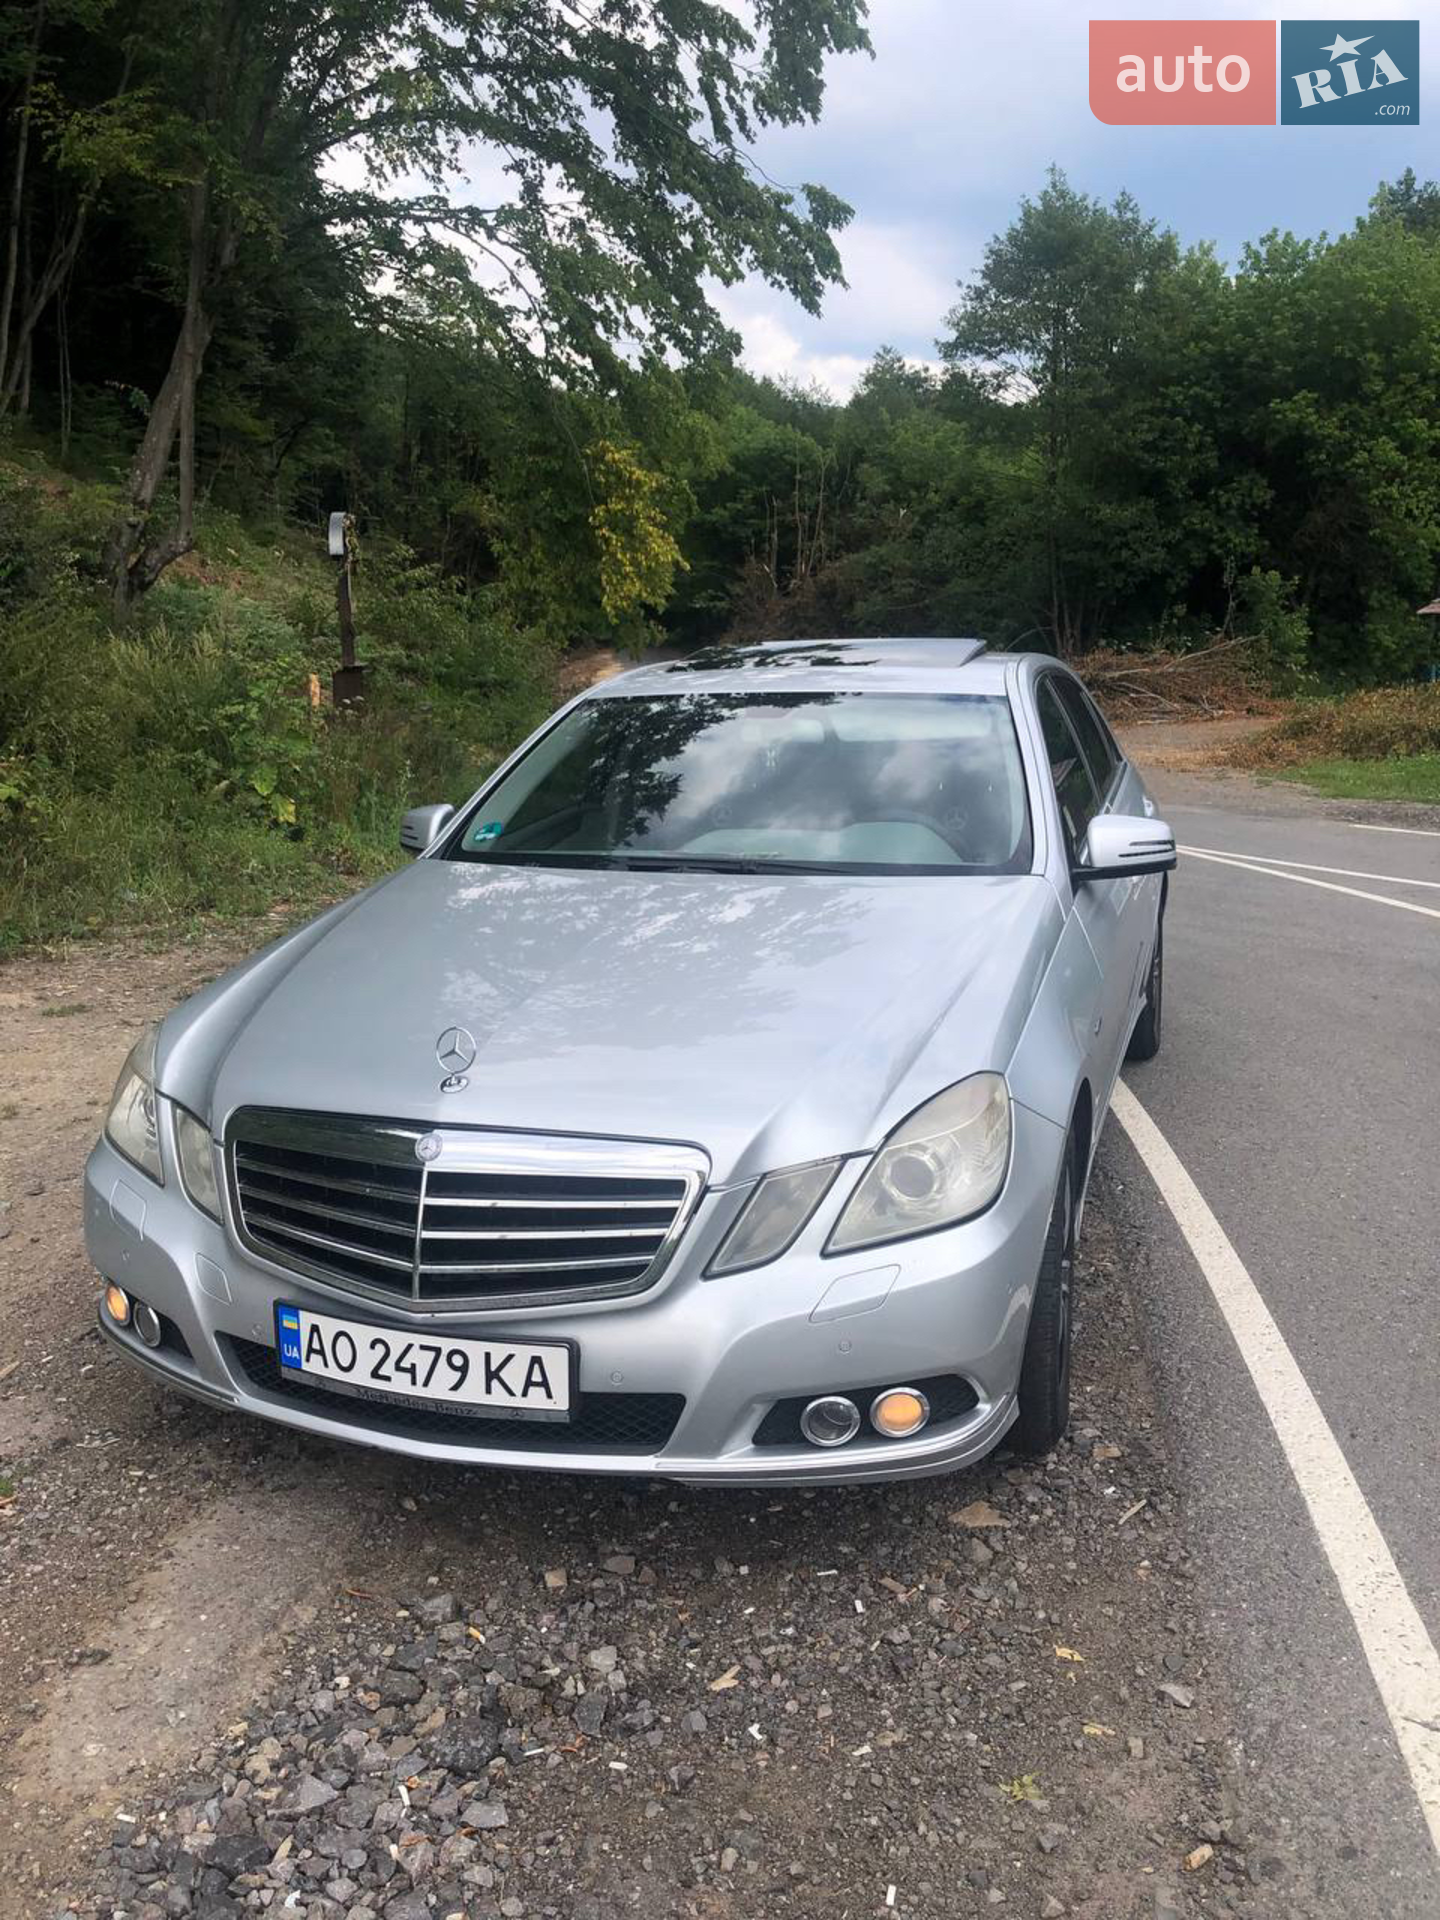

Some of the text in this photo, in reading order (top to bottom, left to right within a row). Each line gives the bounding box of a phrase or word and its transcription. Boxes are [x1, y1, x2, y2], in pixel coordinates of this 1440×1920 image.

[284, 1344, 300, 1359] UA
[305, 1323, 554, 1400] AO 2479 KA
